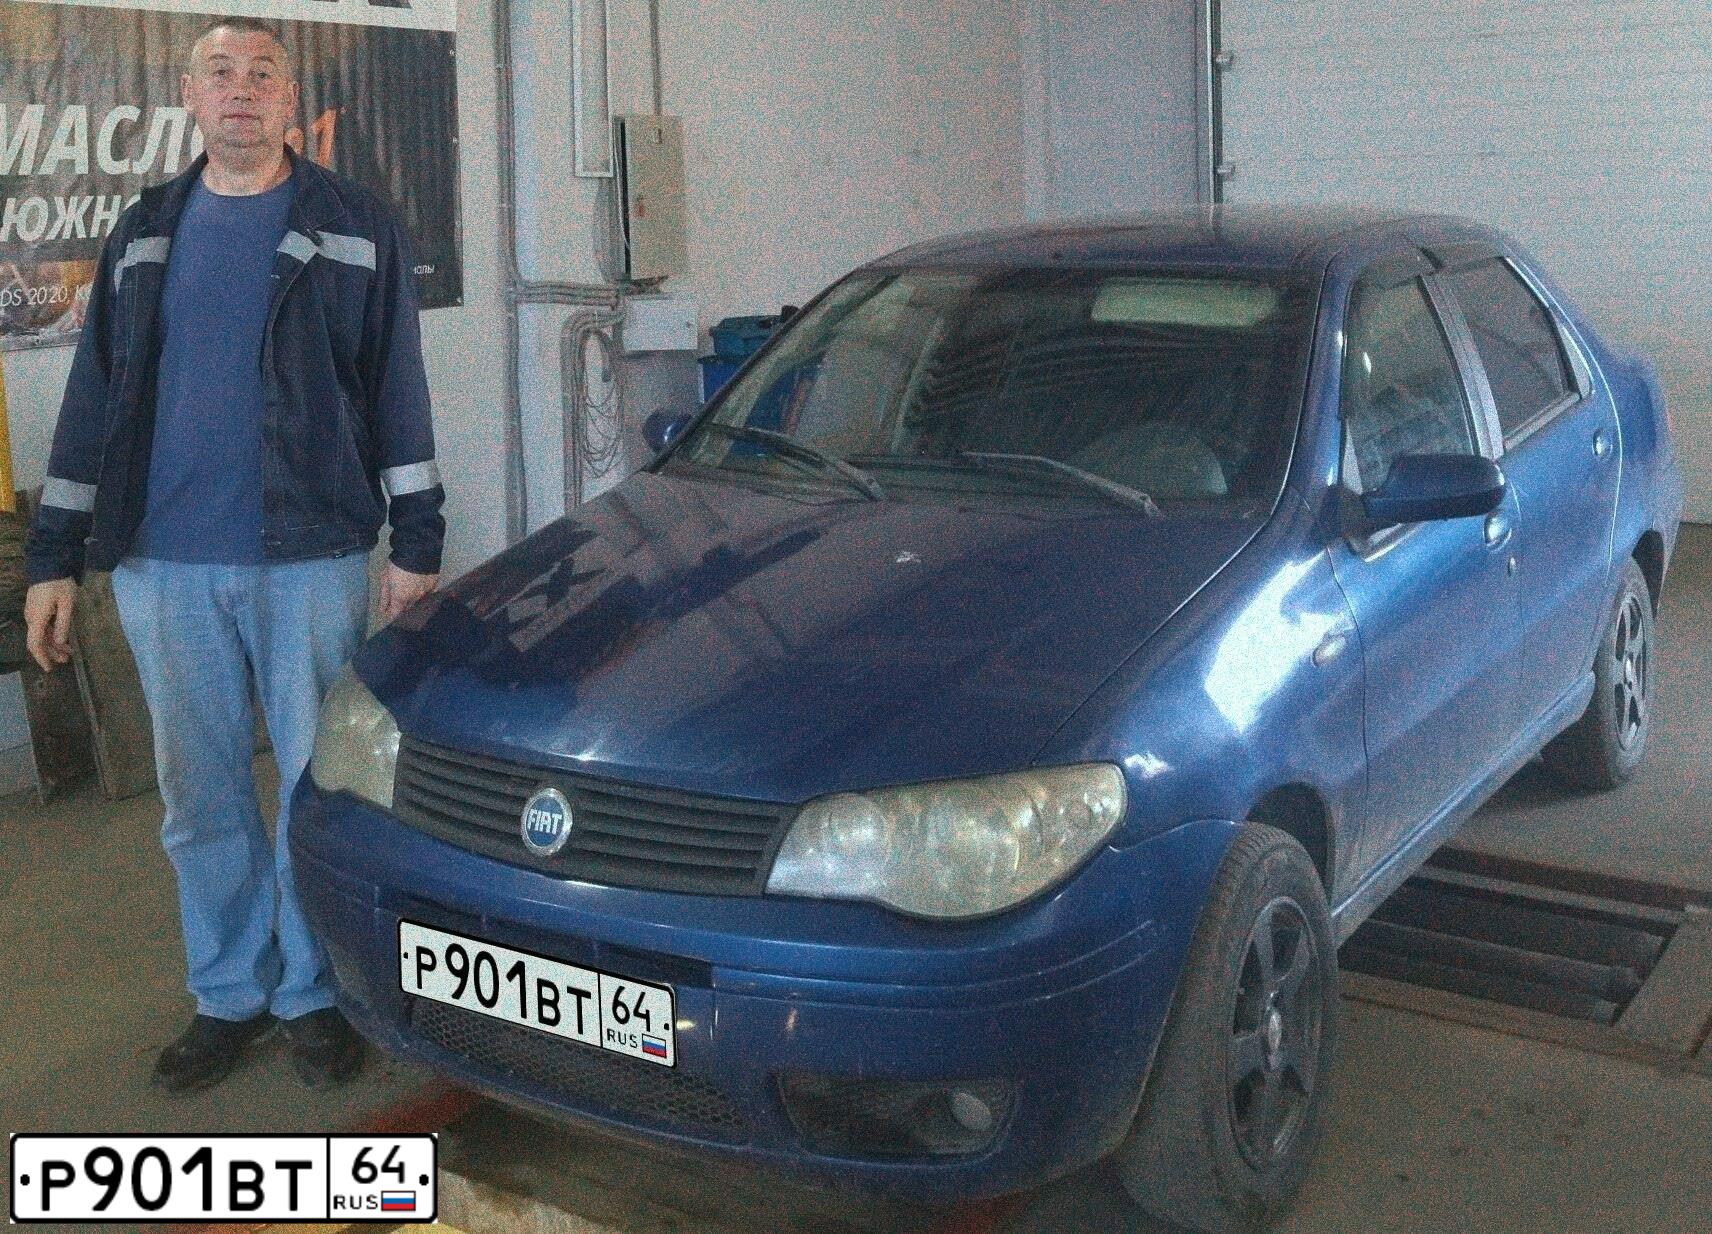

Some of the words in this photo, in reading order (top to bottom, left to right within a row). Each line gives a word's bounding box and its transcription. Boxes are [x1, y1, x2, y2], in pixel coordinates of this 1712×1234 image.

[0, 104, 205, 175] МАСЛ
[0, 194, 141, 242] ЮЖН
[527, 808, 562, 835] FIAT
[416, 943, 591, 1034] Р901ВТ
[612, 985, 651, 1032] 64
[606, 1028, 638, 1048] RUS
